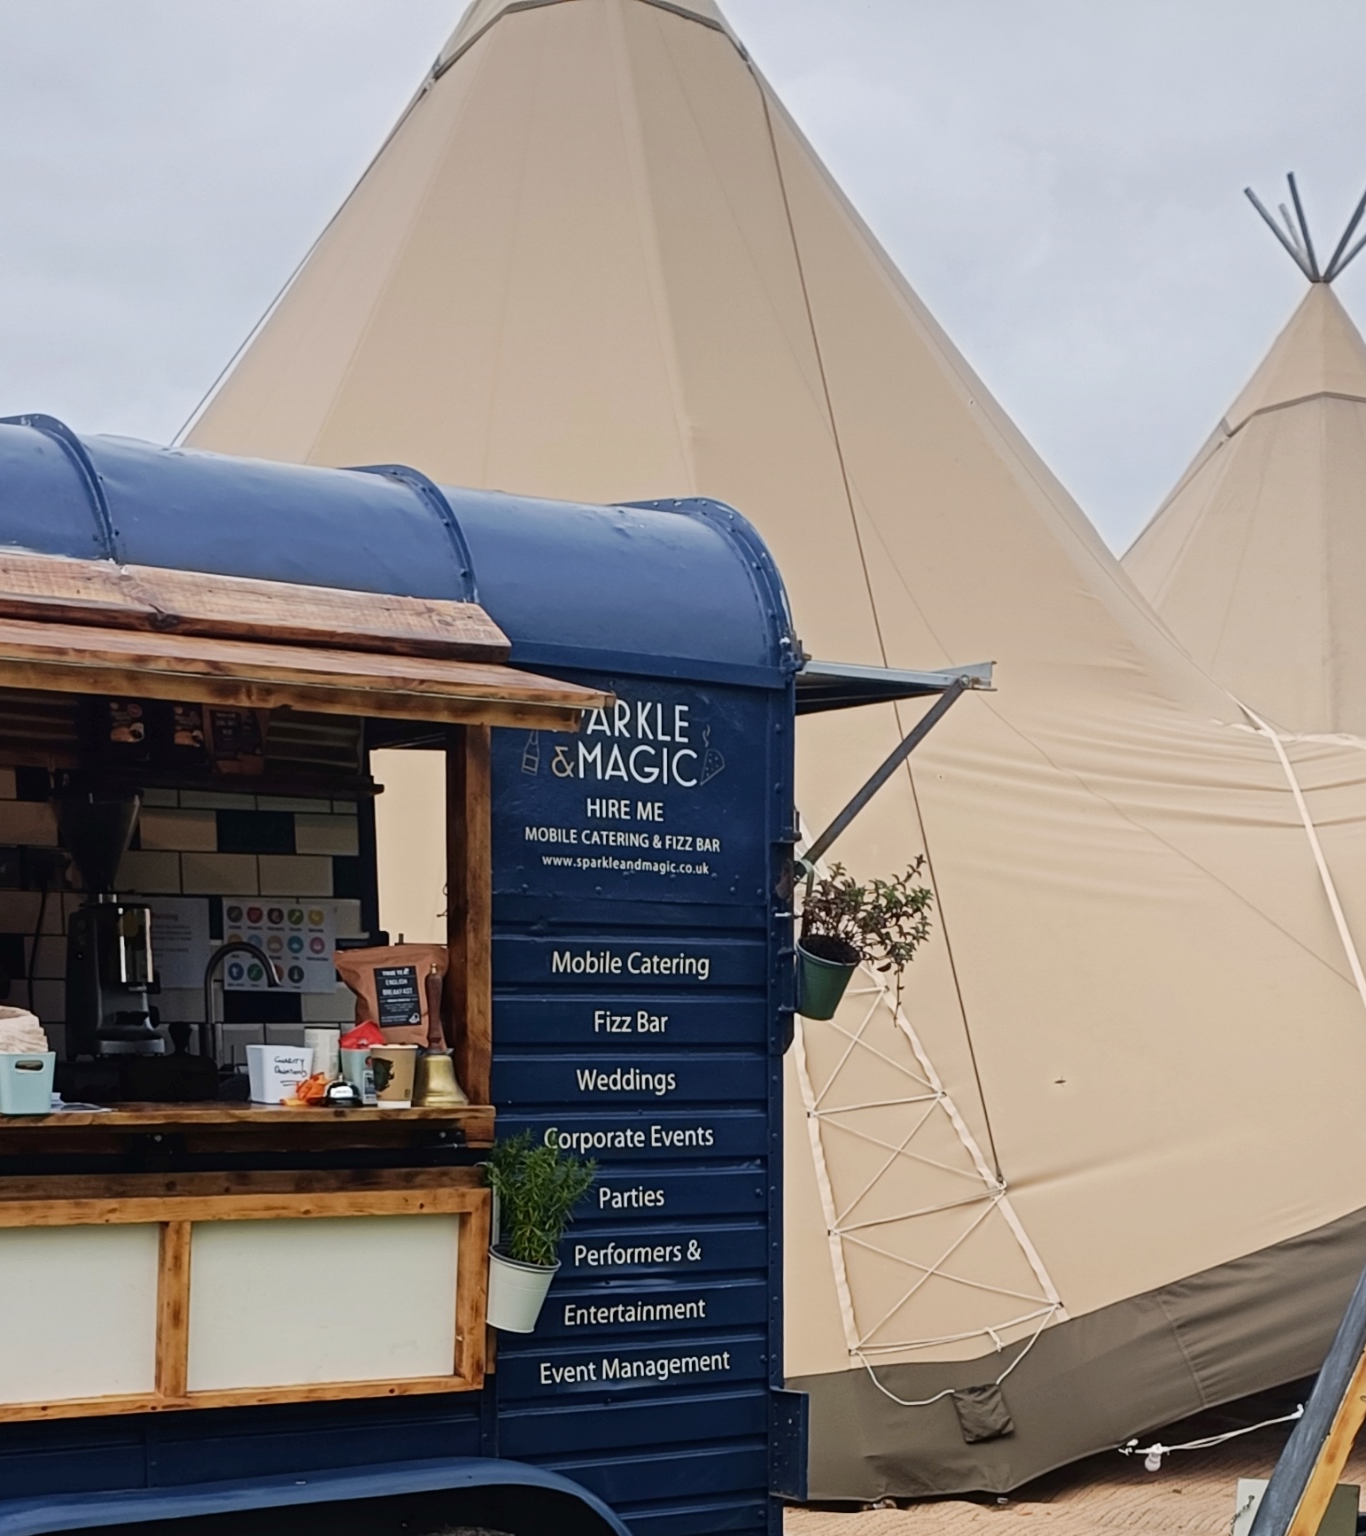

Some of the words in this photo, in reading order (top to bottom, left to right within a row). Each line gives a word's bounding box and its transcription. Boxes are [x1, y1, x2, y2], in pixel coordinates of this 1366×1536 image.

[581, 699, 689, 743] ARKLE
[586, 797, 631, 820] HIRE
[636, 801, 664, 822] ME
[525, 826, 578, 844] MOBILE
[581, 829, 650, 848] CATERING
[652, 834, 662, 849] &
[665, 835, 693, 851] FIZZ
[696, 837, 720, 853] BAR
[541, 856, 709, 875] www.sparkleandmagic.co.uk
[552, 950, 623, 974] Mobile
[627, 951, 710, 981] Catering
[594, 1010, 632, 1033] Fizz
[637, 1010, 669, 1033] Bar
[576, 1067, 676, 1096] Weddings
[544, 1127, 645, 1154] Corporate
[651, 1125, 714, 1147] Events
[599, 1185, 665, 1209] Parties
[575, 1242, 682, 1267] Performers
[686, 1239, 702, 1261] &
[564, 1299, 706, 1326] Entertainment
[540, 1361, 597, 1385] Event
[602, 1351, 731, 1381] Management
